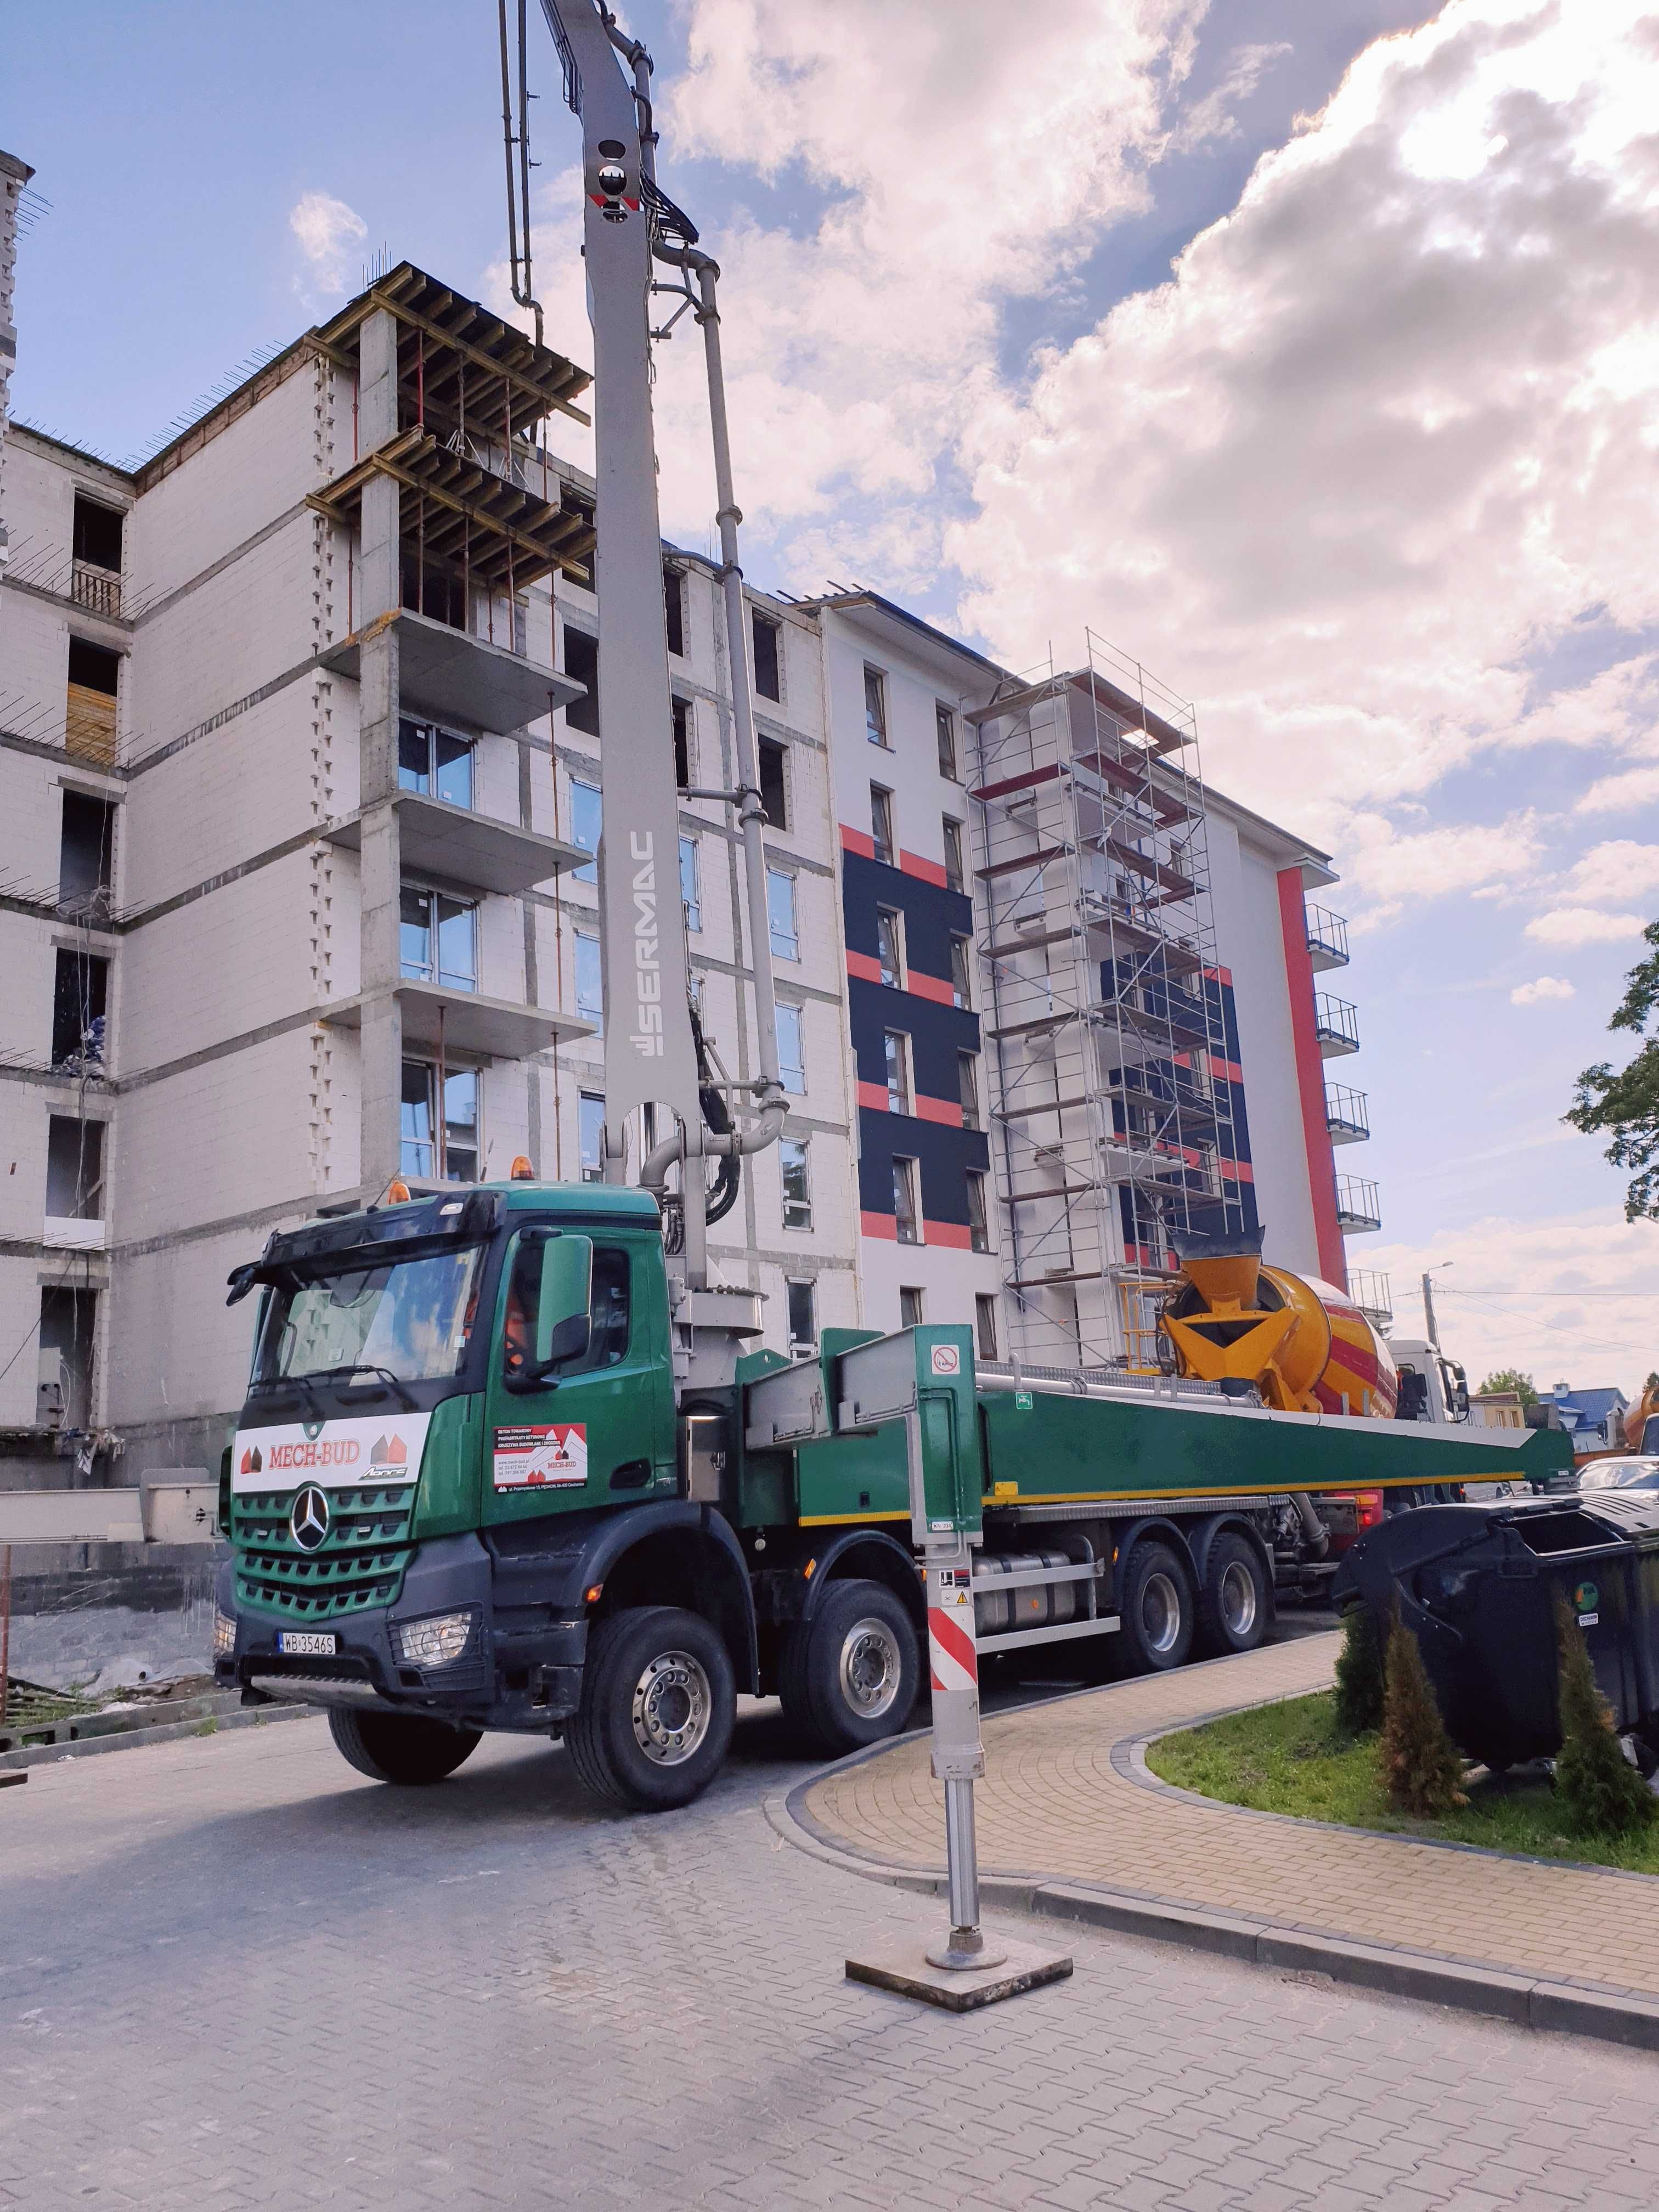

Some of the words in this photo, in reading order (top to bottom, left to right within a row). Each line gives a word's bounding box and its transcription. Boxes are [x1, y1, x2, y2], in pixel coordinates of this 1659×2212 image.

[630, 831, 663, 1033] SERMAC
[269, 1440, 361, 1470] MECH-BUD
[285, 1635, 298, 1651] WB
[302, 1636, 333, 1654] 3546S
